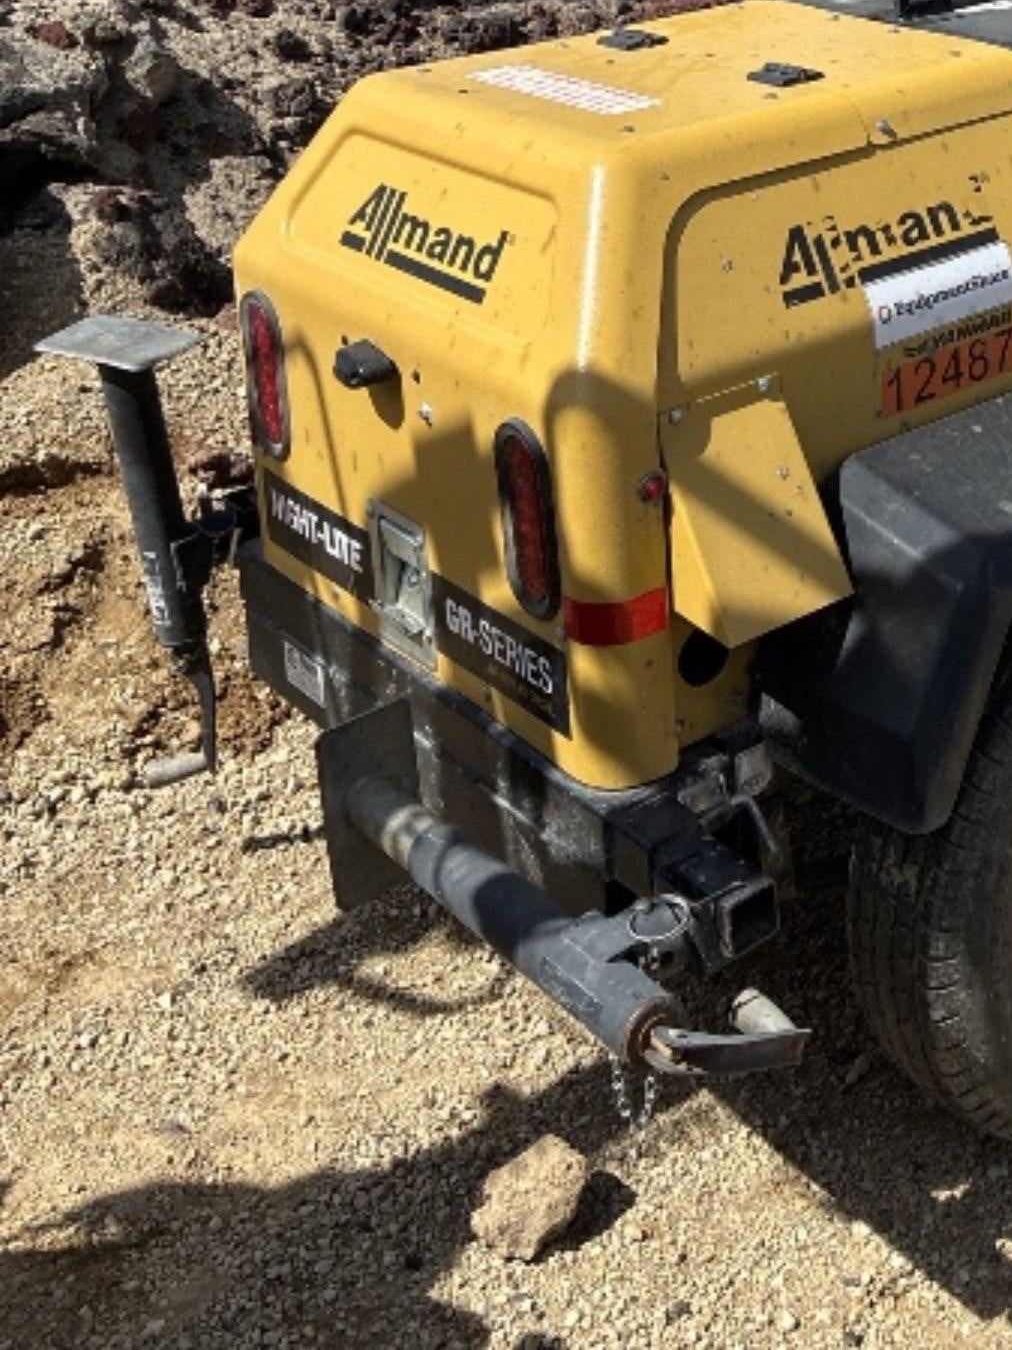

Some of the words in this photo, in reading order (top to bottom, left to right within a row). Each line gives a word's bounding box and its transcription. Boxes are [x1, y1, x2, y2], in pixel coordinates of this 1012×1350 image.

[347, 182, 510, 283] Allmand
[270, 488, 363, 574] NIGHT-LITE
[446, 595, 553, 694] GR-SERIES
